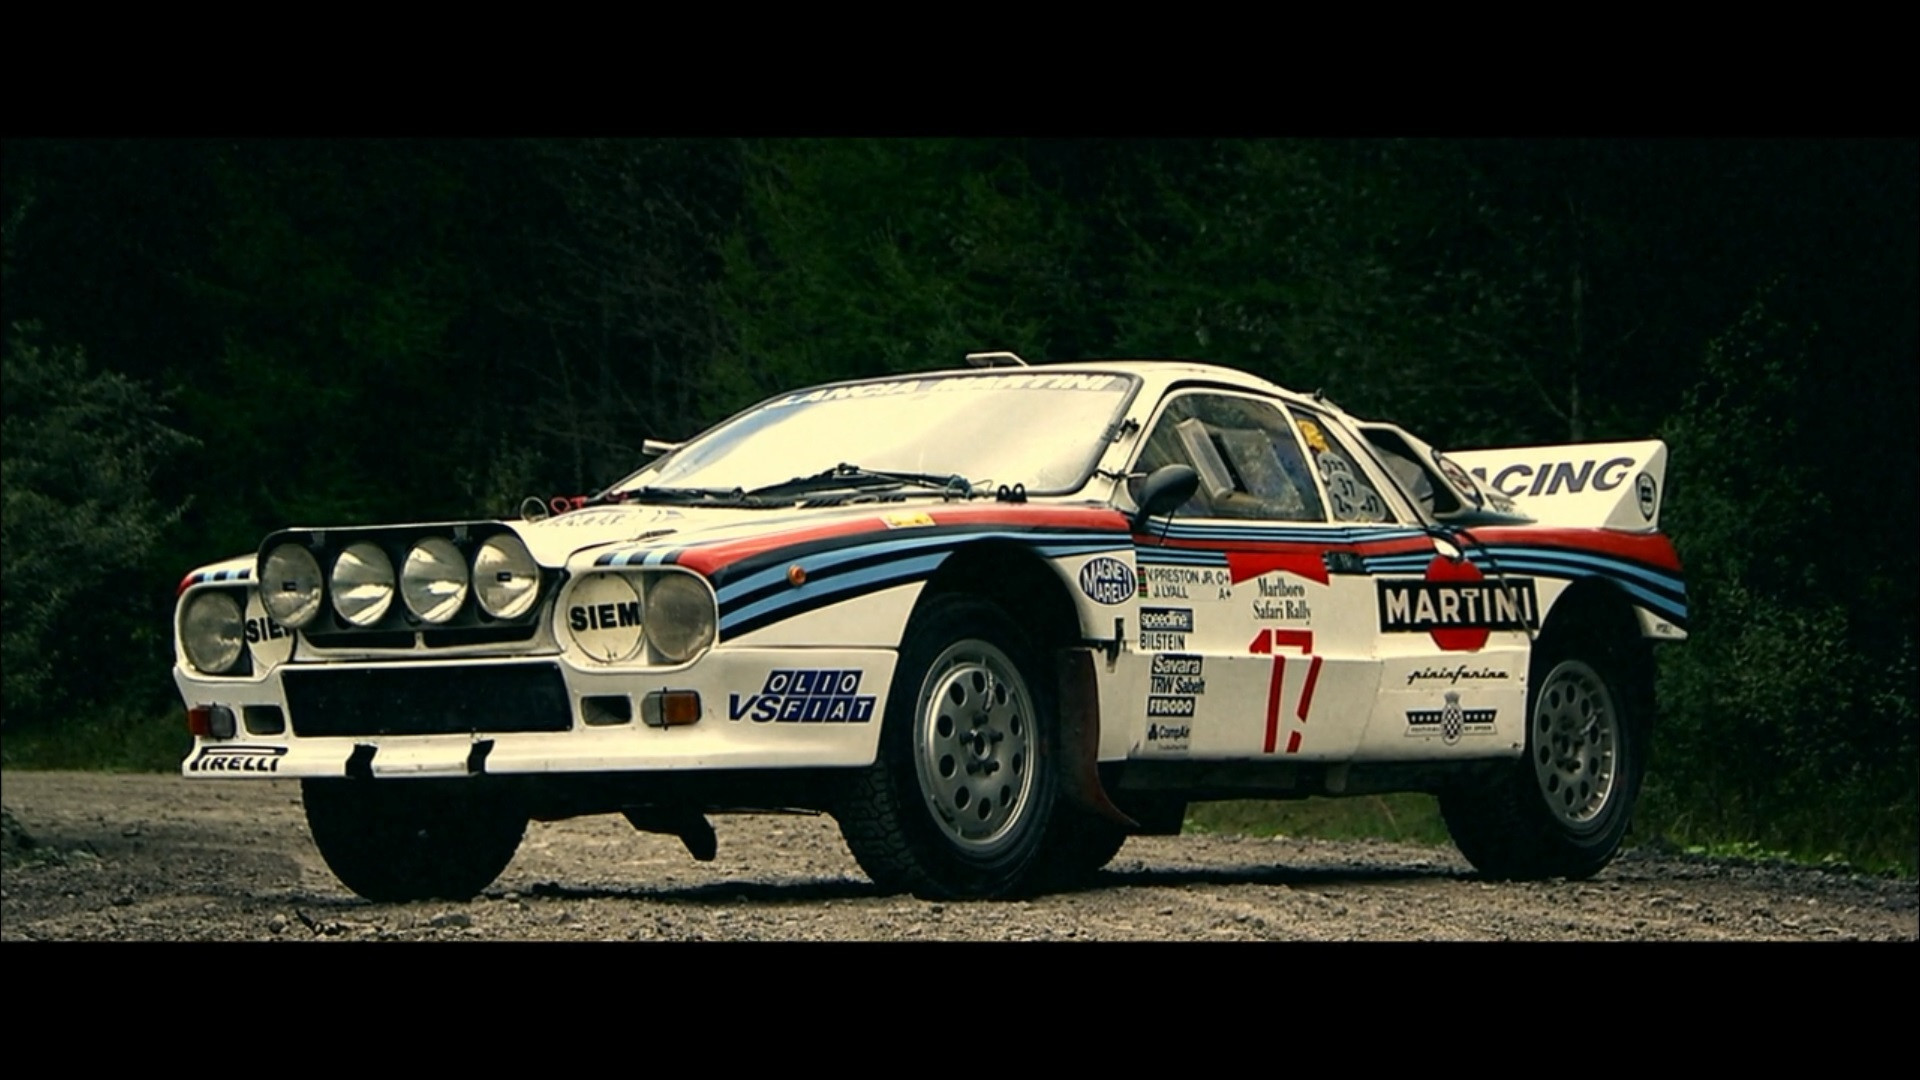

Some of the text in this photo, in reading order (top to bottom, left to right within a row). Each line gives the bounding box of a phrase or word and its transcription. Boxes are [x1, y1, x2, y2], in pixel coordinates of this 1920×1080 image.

[936, 376, 1115, 391] MARTINI
[1257, 578, 1305, 598] Marlboro
[1253, 600, 1311, 625] Safari Rally
[1385, 587, 1533, 624] MARTINI
[570, 602, 641, 631] SIEM
[1140, 633, 1186, 650] BILSTEIN
[1154, 655, 1200, 674] Savara
[769, 673, 858, 694] OLIO
[1151, 676, 1174, 693] TRW
[1249, 629, 1323, 754] 17
[783, 699, 871, 720] FIAT
[1150, 699, 1193, 713] FERODO
[189, 746, 288, 771] PIRELLI
